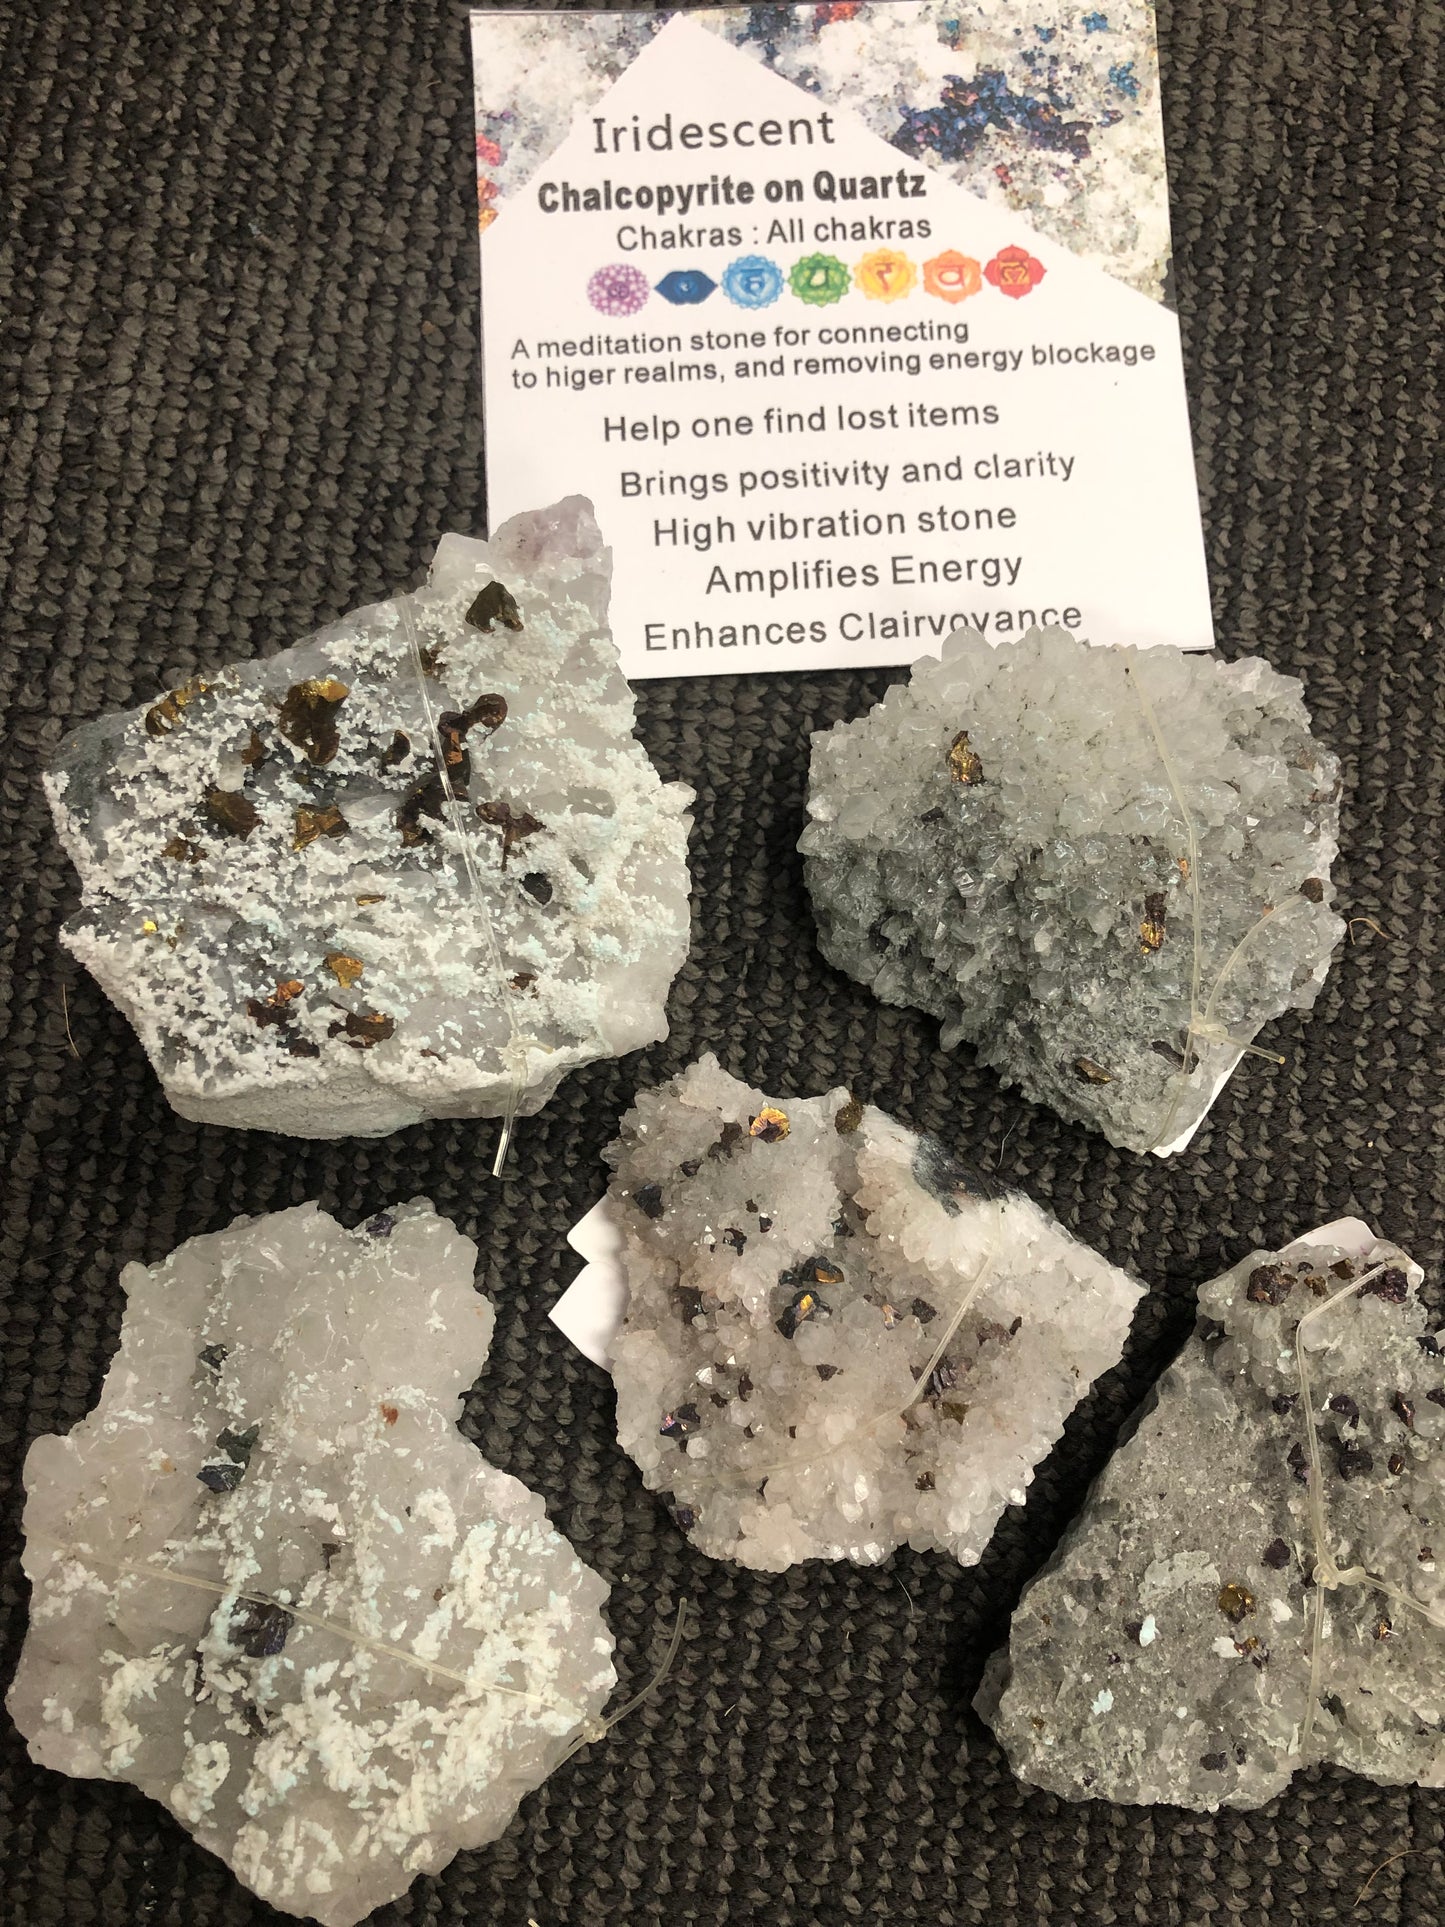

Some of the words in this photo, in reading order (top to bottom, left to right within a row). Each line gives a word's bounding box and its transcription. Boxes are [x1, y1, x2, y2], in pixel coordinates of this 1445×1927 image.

[593, 112, 835, 153] Iridescent
[538, 175, 754, 215] Chalcopyrite
[764, 179, 804, 203] on
[813, 169, 926, 203] Quartz
[617, 224, 742, 251] Chakras
[767, 218, 804, 244] All
[814, 216, 931, 242] chakras
[511, 339, 530, 359] A
[537, 333, 681, 358] meditation
[691, 330, 766, 351] stone
[774, 326, 811, 347] for
[818, 320, 969, 344] connecting
[512, 369, 537, 389] to
[547, 366, 616, 391] higer
[624, 361, 724, 384] realms,
[735, 355, 784, 378] and
[794, 351, 921, 375] removing
[929, 350, 1023, 372] energy
[1032, 342, 1155, 366] blockage
[604, 415, 680, 446] Help
[692, 416, 753, 438] one
[764, 406, 825, 434] find
[838, 404, 899, 430] lost
[909, 402, 999, 427] items
[621, 470, 728, 500] Brings
[740, 460, 889, 497] positivity
[902, 456, 962, 483] and
[974, 451, 1074, 482] clarity
[654, 516, 735, 552] High
[747, 509, 905, 541] vibration
[918, 505, 1016, 532] stone
[706, 560, 879, 598] Amplifies
[891, 555, 1022, 587] Energy
[645, 621, 827, 651] Enhances
